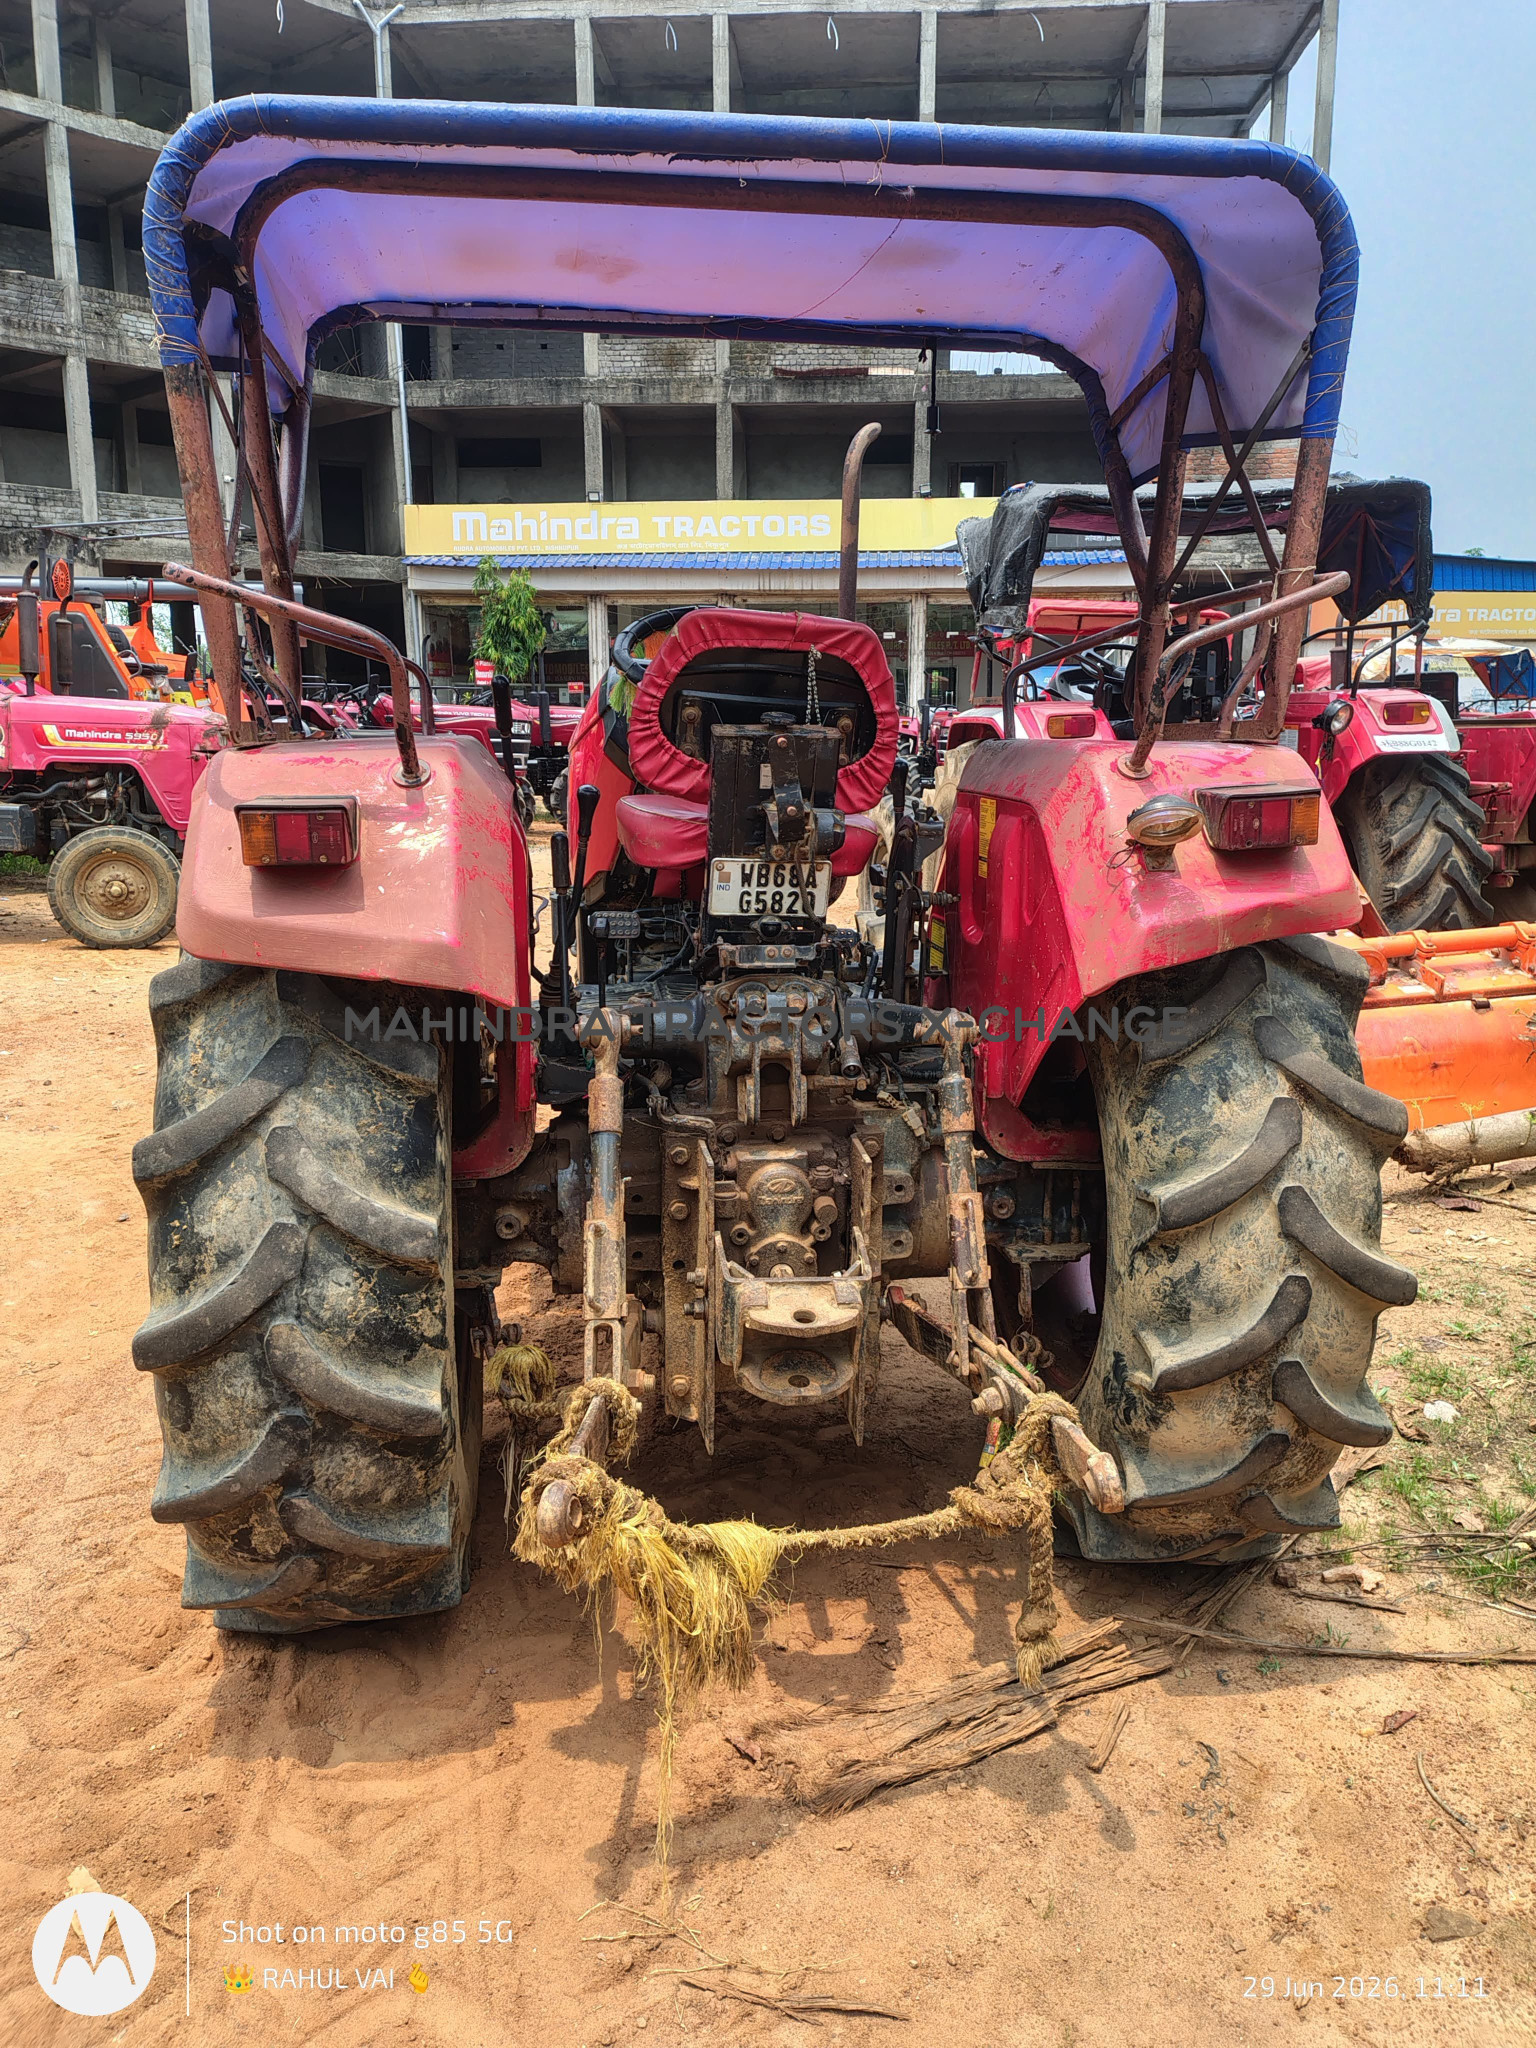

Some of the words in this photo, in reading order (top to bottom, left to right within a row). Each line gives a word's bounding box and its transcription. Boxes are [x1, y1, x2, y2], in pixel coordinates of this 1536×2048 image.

[452, 510, 640, 541] Mahindra
[652, 514, 831, 538] TRACTORS
[65, 729, 121, 739] Mahindra
